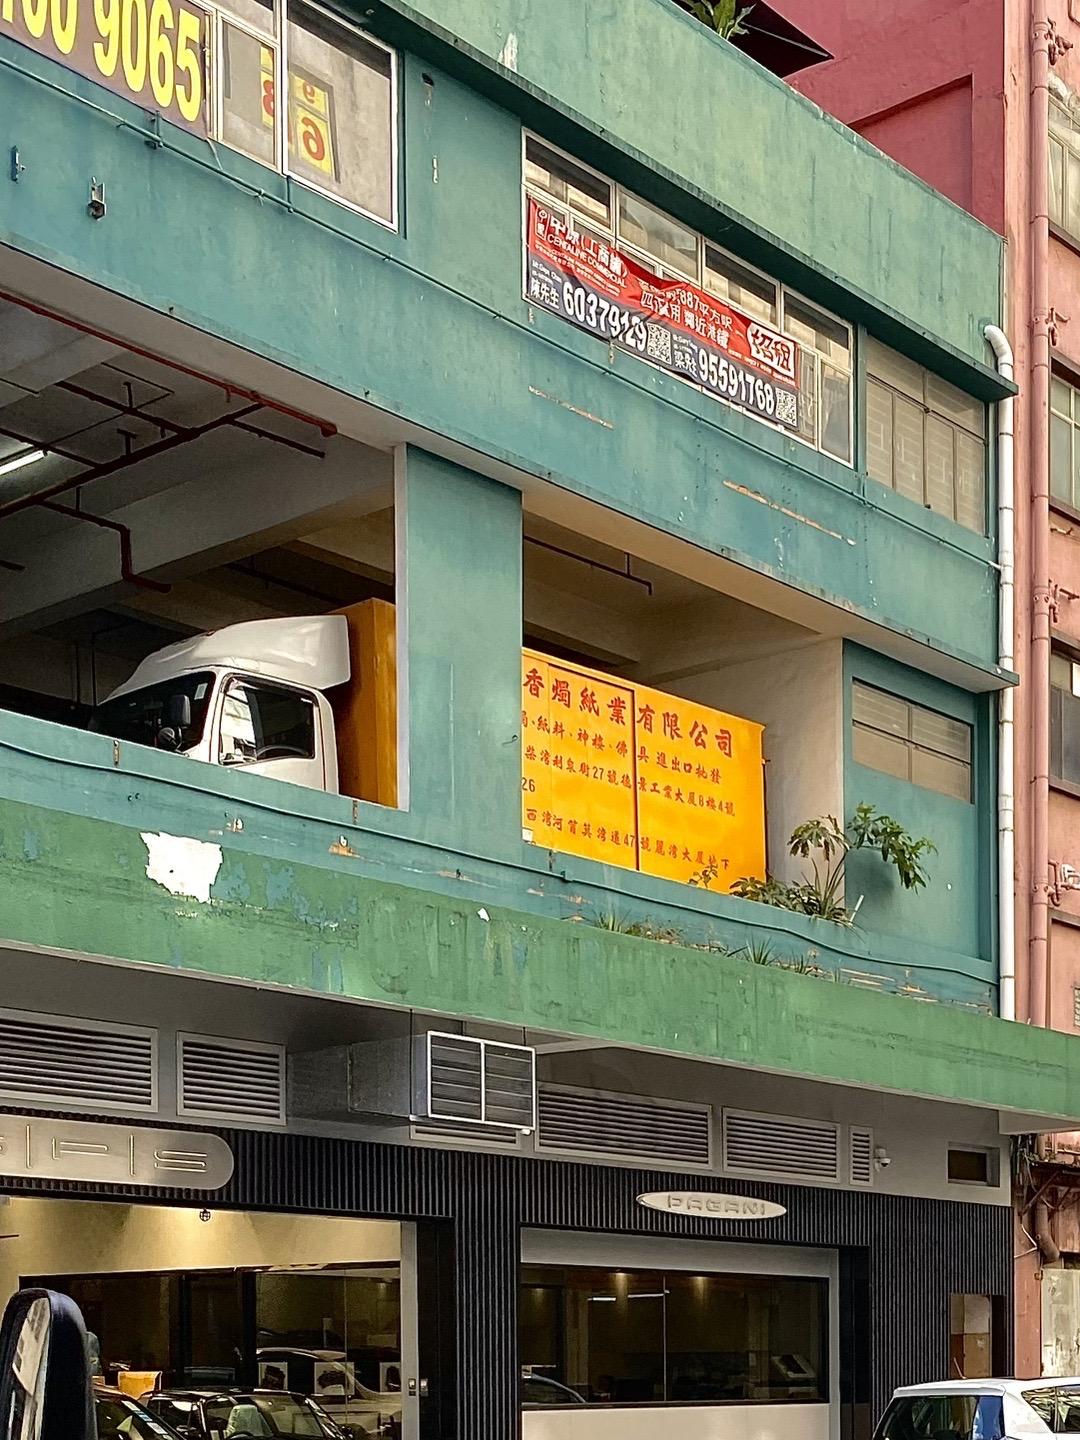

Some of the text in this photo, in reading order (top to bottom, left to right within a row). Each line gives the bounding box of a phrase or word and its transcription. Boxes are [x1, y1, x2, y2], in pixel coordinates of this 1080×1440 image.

[93, 0, 202, 123] 9065
[563, 281, 648, 352] 60379129
[751, 328, 792, 373] 招租
[699, 348, 775, 416] 95591768
[667, 1194, 766, 1216] PAGANI
